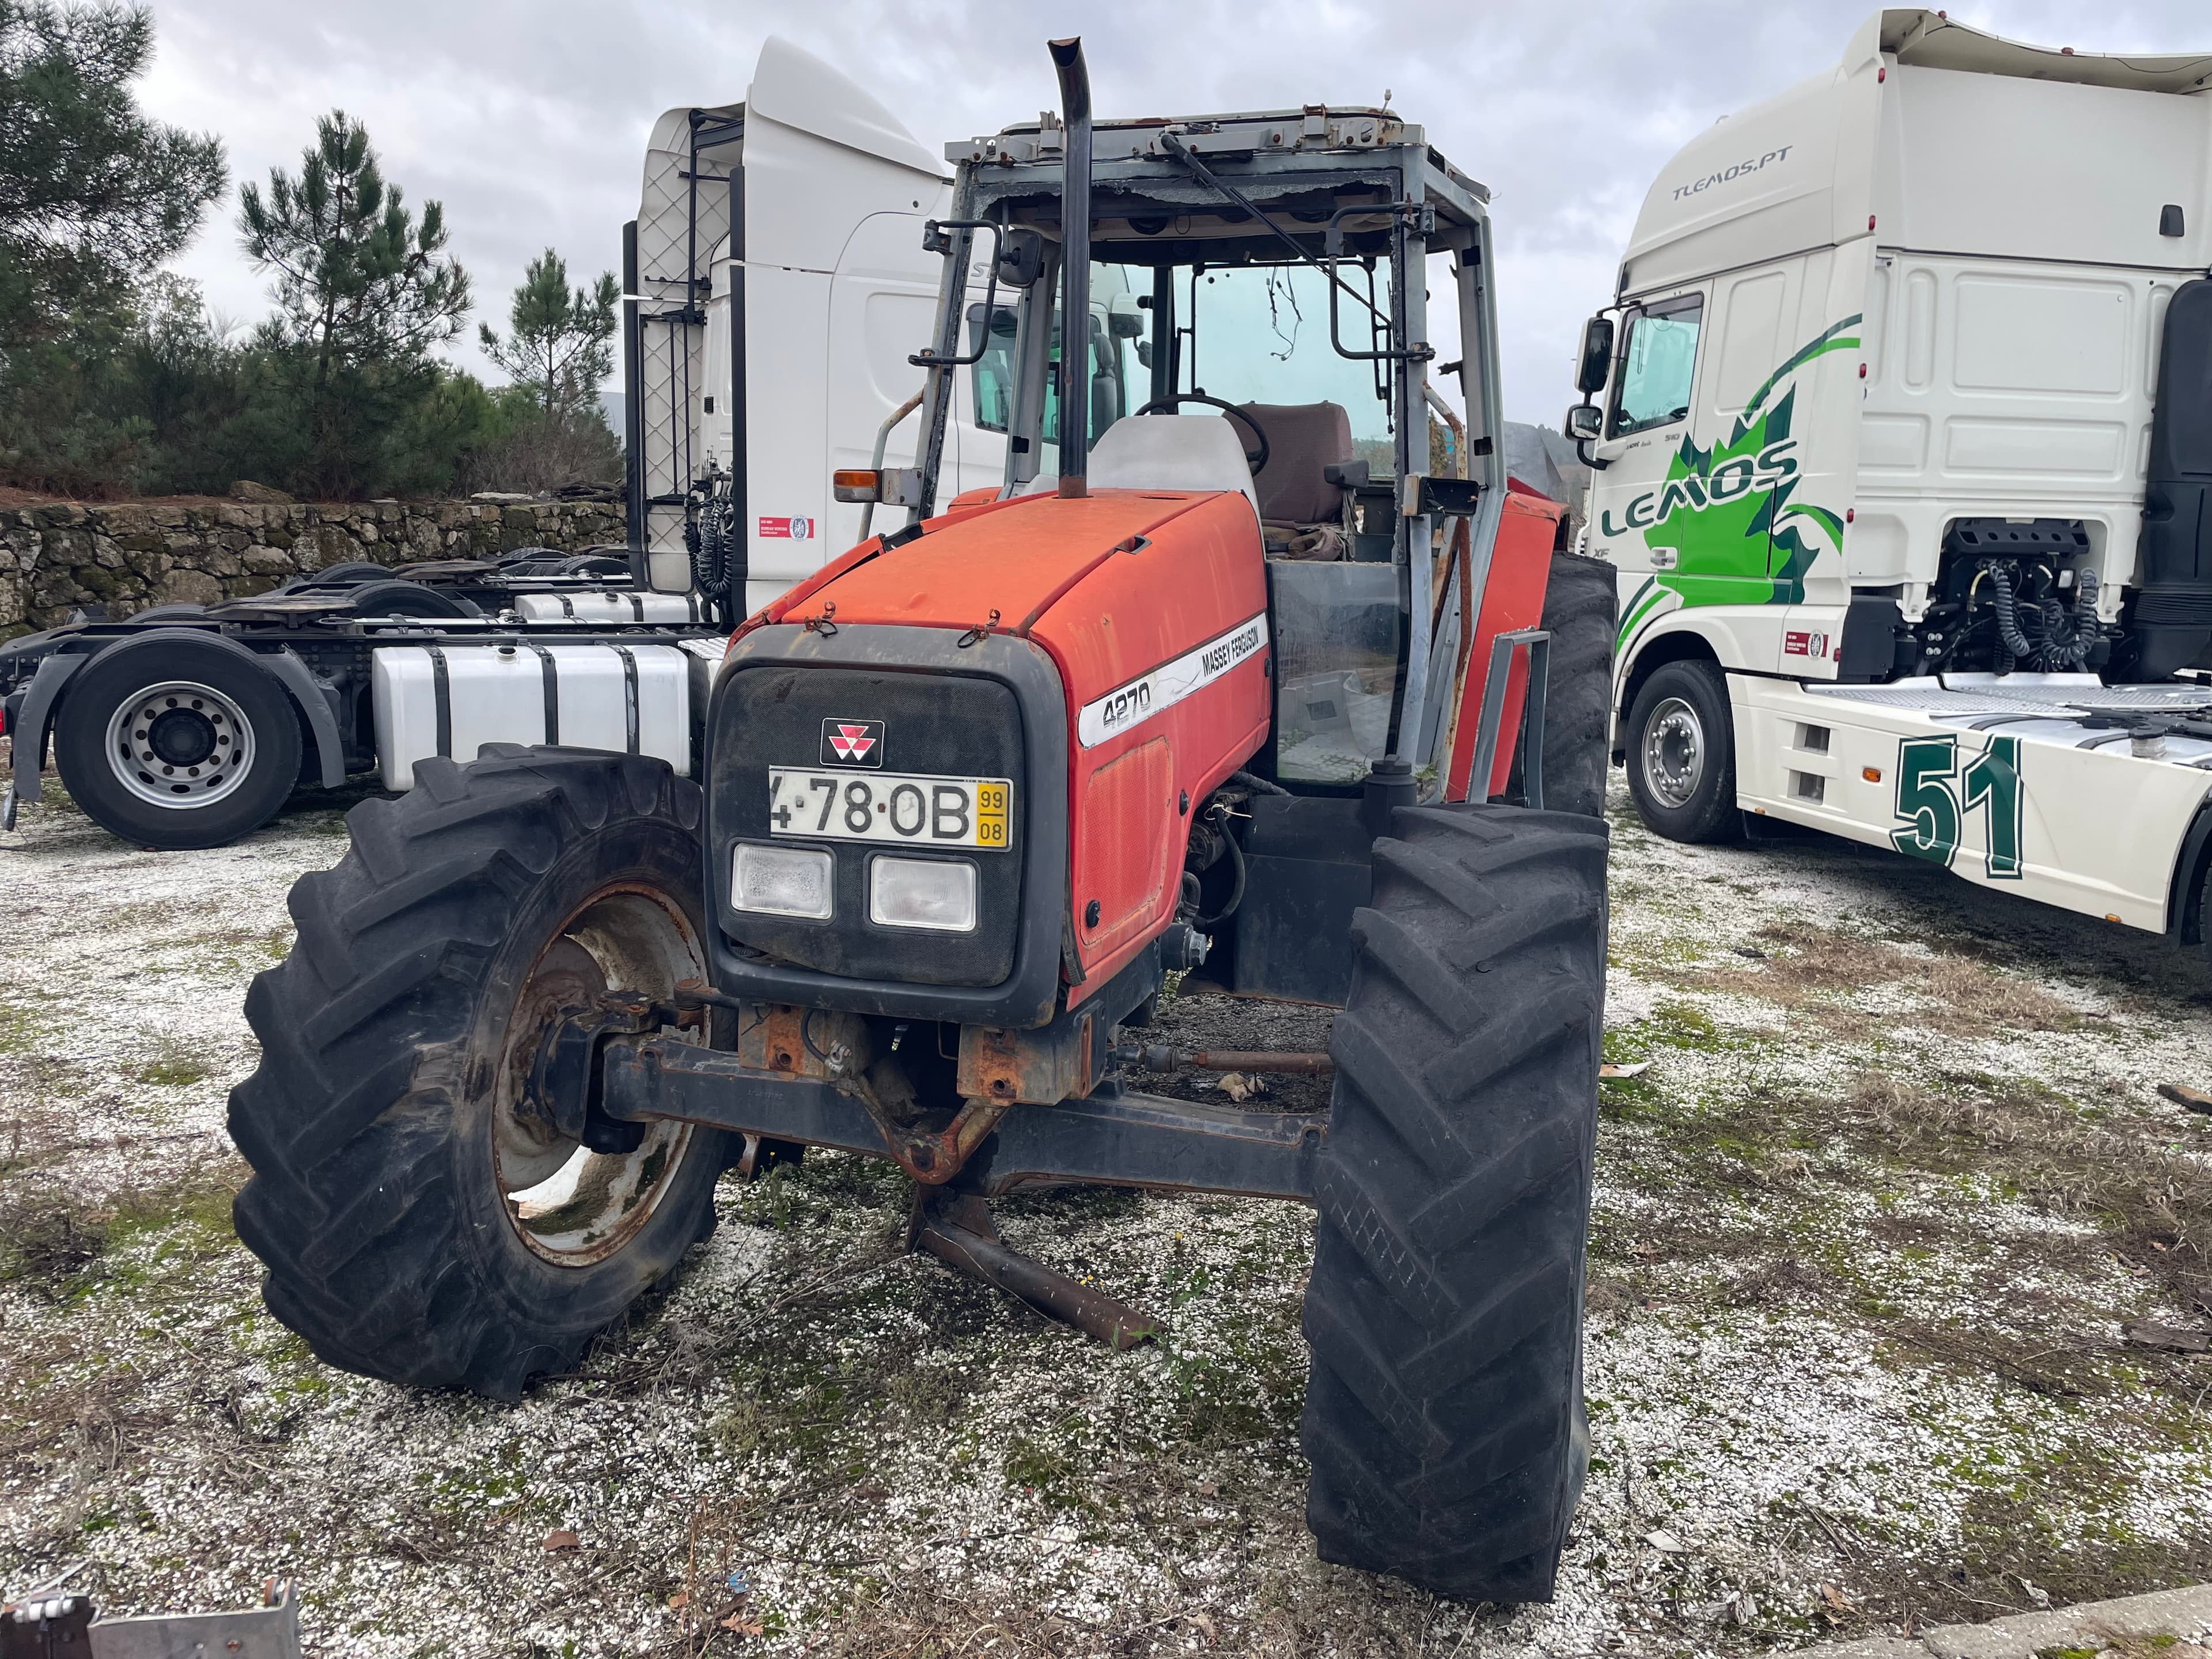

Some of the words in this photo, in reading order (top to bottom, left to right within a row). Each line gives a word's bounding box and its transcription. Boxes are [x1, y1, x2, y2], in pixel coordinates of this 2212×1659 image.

[1673, 145, 1793, 200] TLEMOS.PT
[1601, 441, 1797, 537] LEMOS
[1593, 548, 1610, 558] XF
[1202, 642, 1231, 677] MASSEY
[1230, 625, 1259, 657] FERGUSON
[1103, 681, 1151, 730] 4270
[980, 790, 1003, 809] 99
[1889, 733, 2025, 880] 51
[980, 823, 1002, 840] 08
